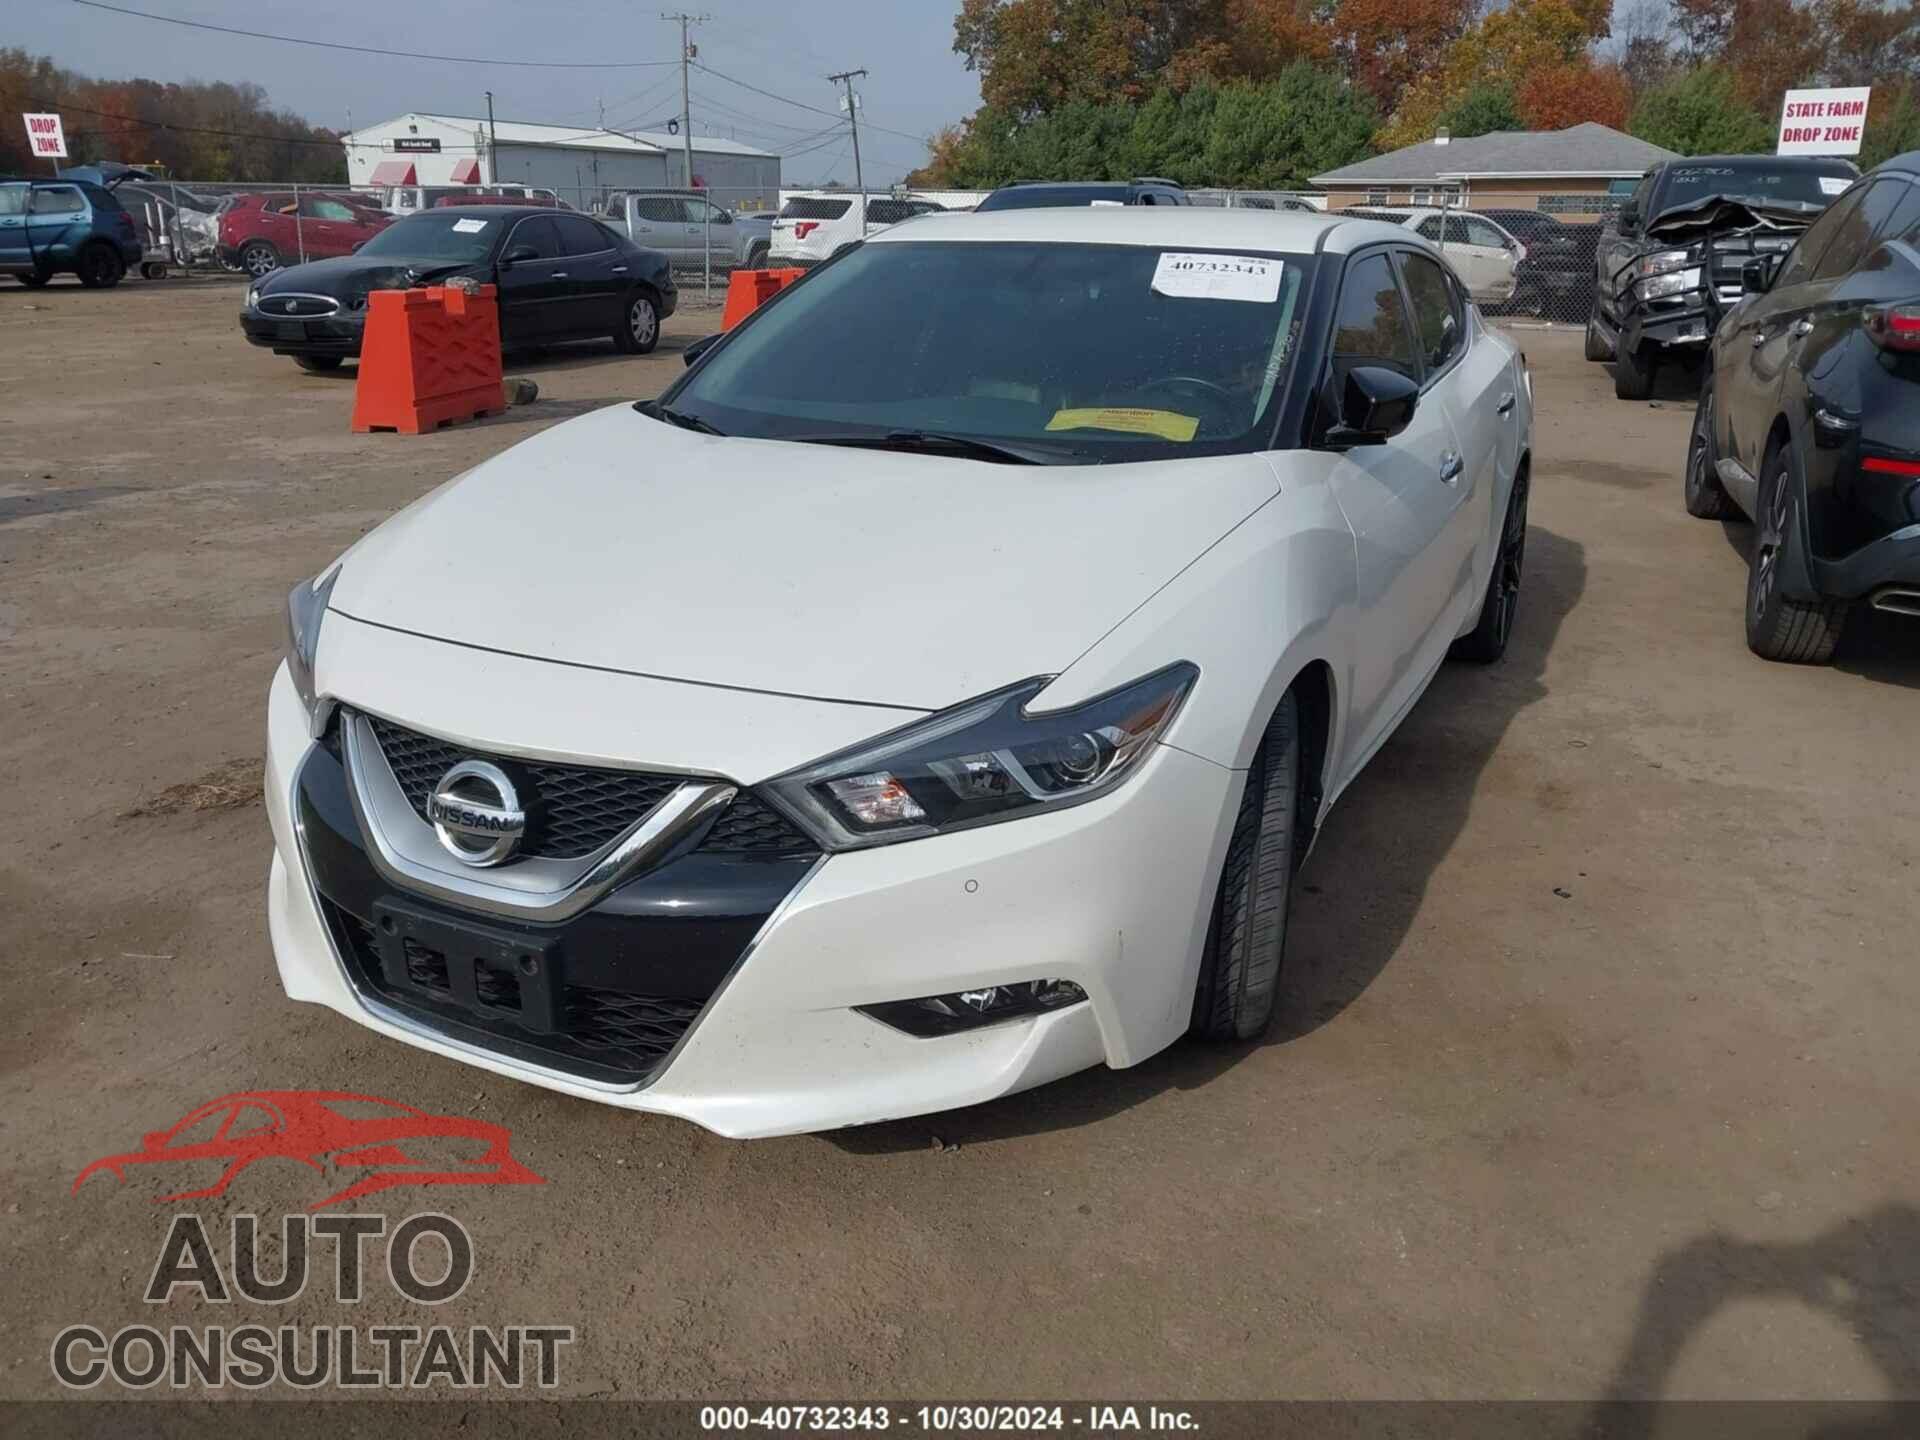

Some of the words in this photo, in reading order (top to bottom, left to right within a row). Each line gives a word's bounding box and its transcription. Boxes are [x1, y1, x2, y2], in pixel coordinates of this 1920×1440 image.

[1786, 102, 1825, 118] STATE
[1826, 101, 1864, 117] FARM
[29, 118, 57, 133] DROP
[1783, 127, 1821, 142] DROP
[1824, 126, 1861, 141] ZONE
[36, 138, 61, 152] ZONE
[1169, 261, 1267, 275] 40732343
[431, 801, 508, 832] NISSAN
